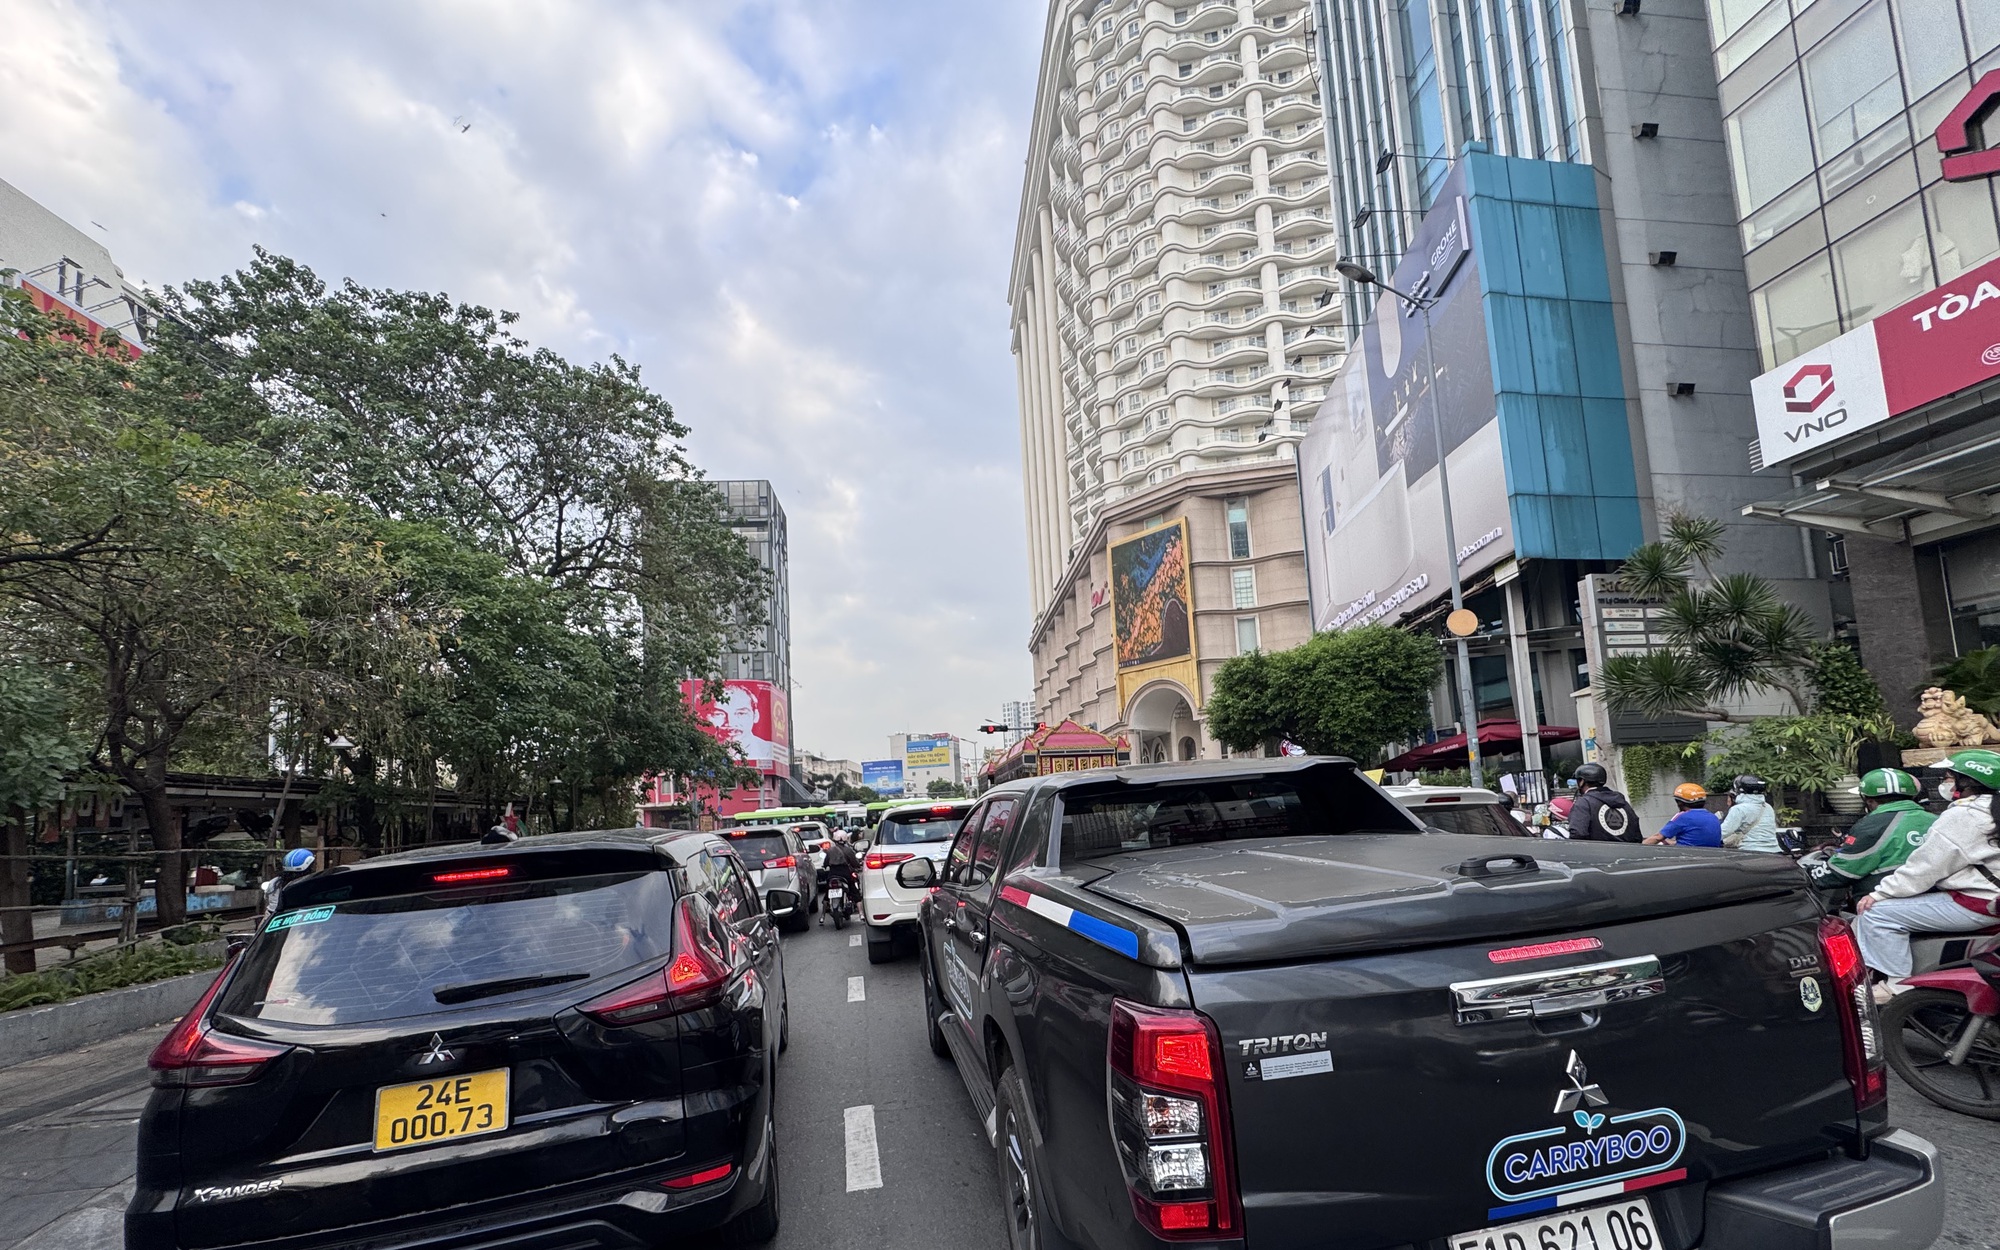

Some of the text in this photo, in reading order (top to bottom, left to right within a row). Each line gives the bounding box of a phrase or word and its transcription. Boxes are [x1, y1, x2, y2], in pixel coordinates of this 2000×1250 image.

[1431, 219, 1457, 266] GROHE
[1912, 281, 2000, 332] TÒA
[1784, 408, 1847, 443] VNO
[1965, 760, 1994, 776] Grab
[269, 918, 283, 929] XE
[1239, 1031, 1328, 1056] TRITON
[416, 1077, 472, 1111] 24E
[391, 1103, 493, 1144] 000.73
[1504, 1125, 1671, 1183] CARRYBOO
[184, 1180, 283, 1203] XPANDER
